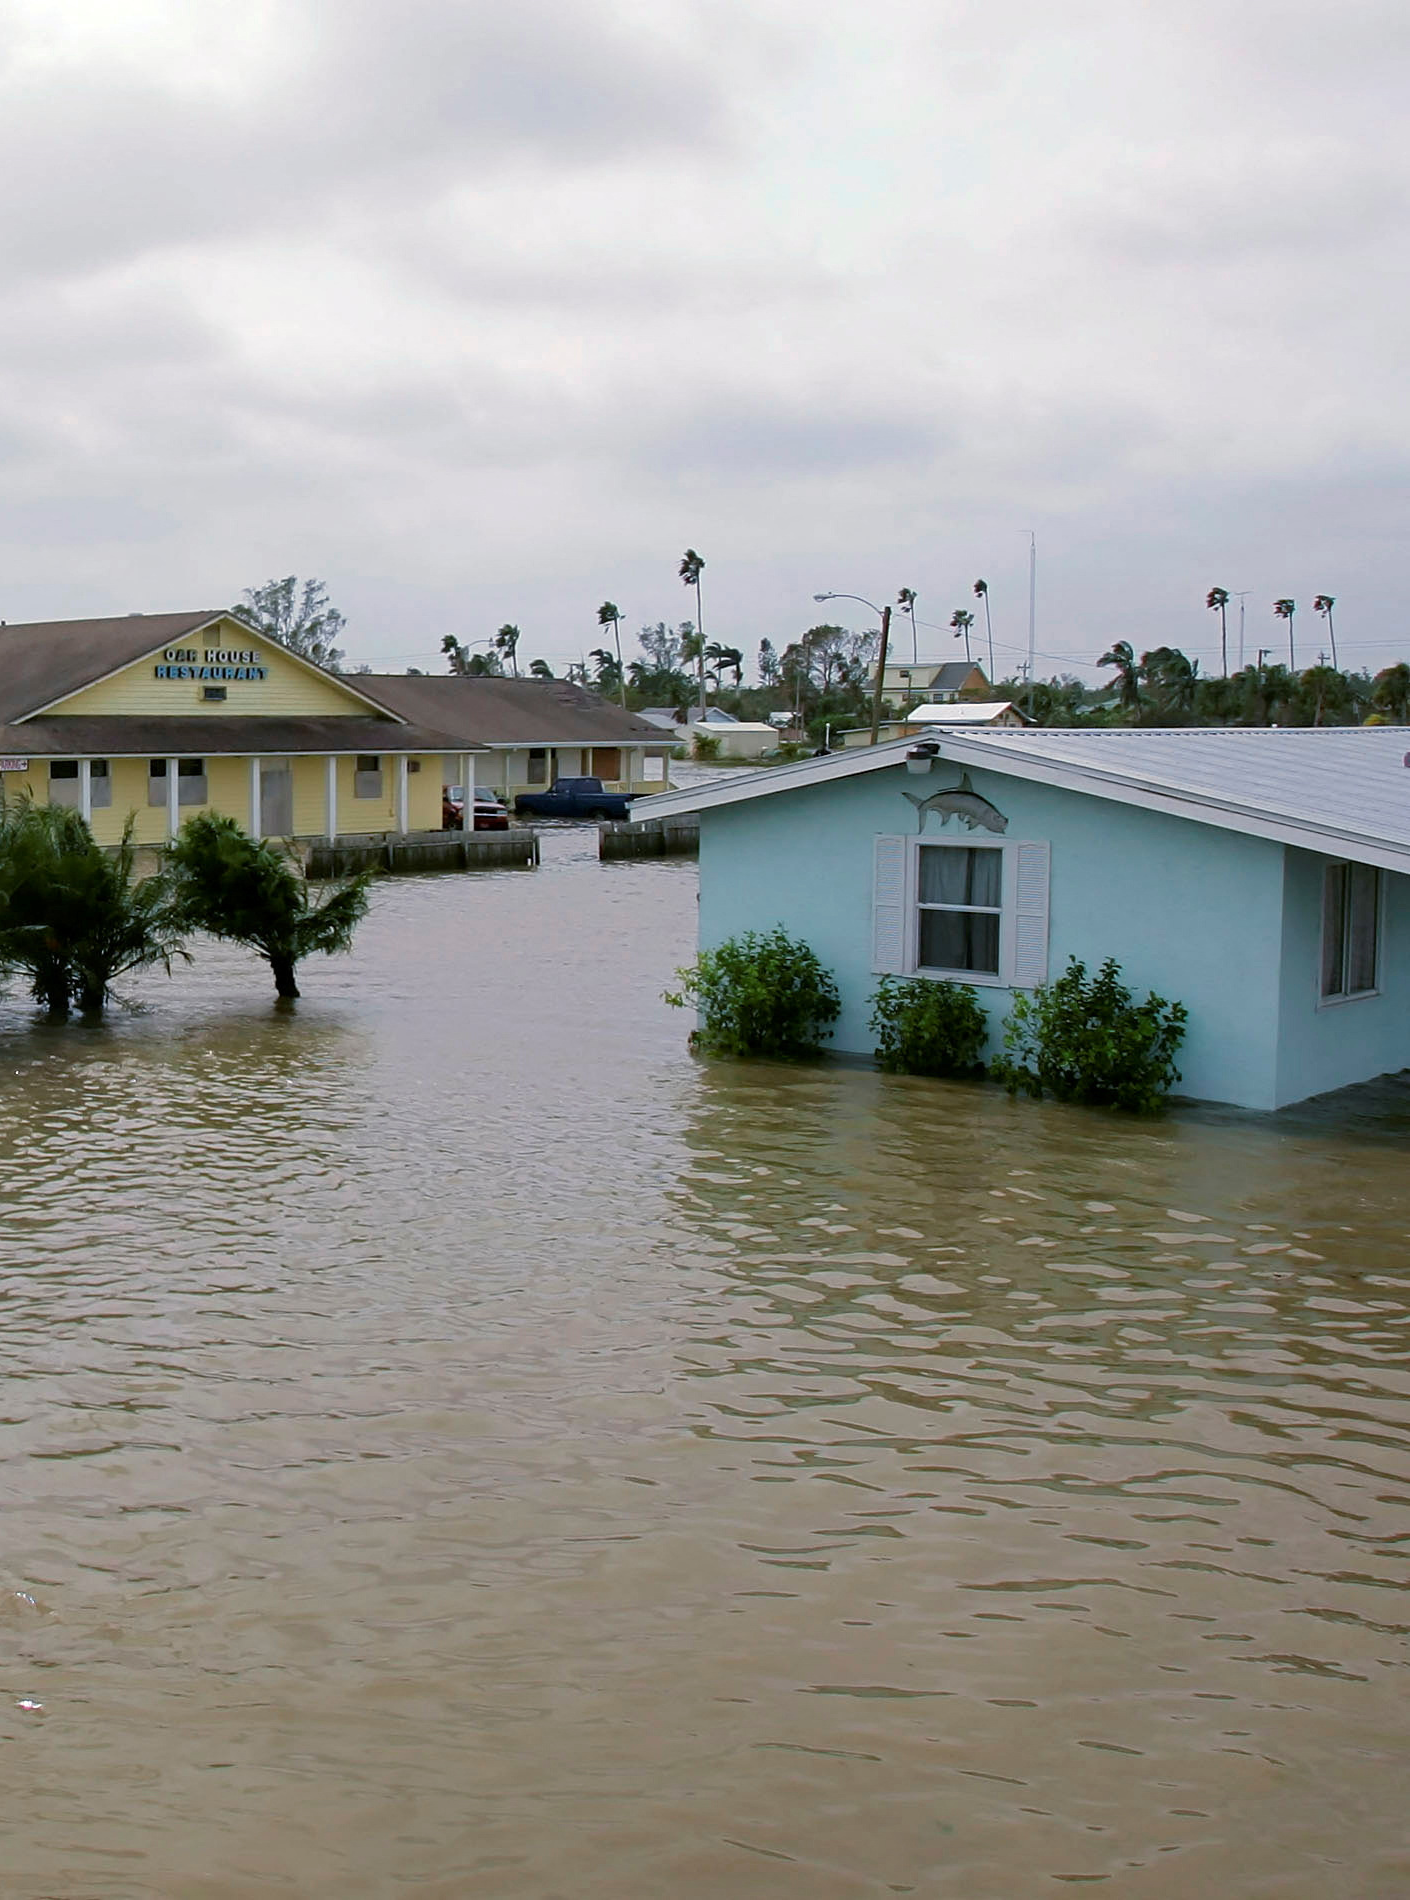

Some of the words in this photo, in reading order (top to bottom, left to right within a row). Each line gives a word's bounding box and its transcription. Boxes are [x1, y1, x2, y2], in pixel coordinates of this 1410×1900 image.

[164, 648, 197, 662] OAR
[205, 649, 262, 663] HOUSE
[155, 666, 269, 680] RESTAURANT
